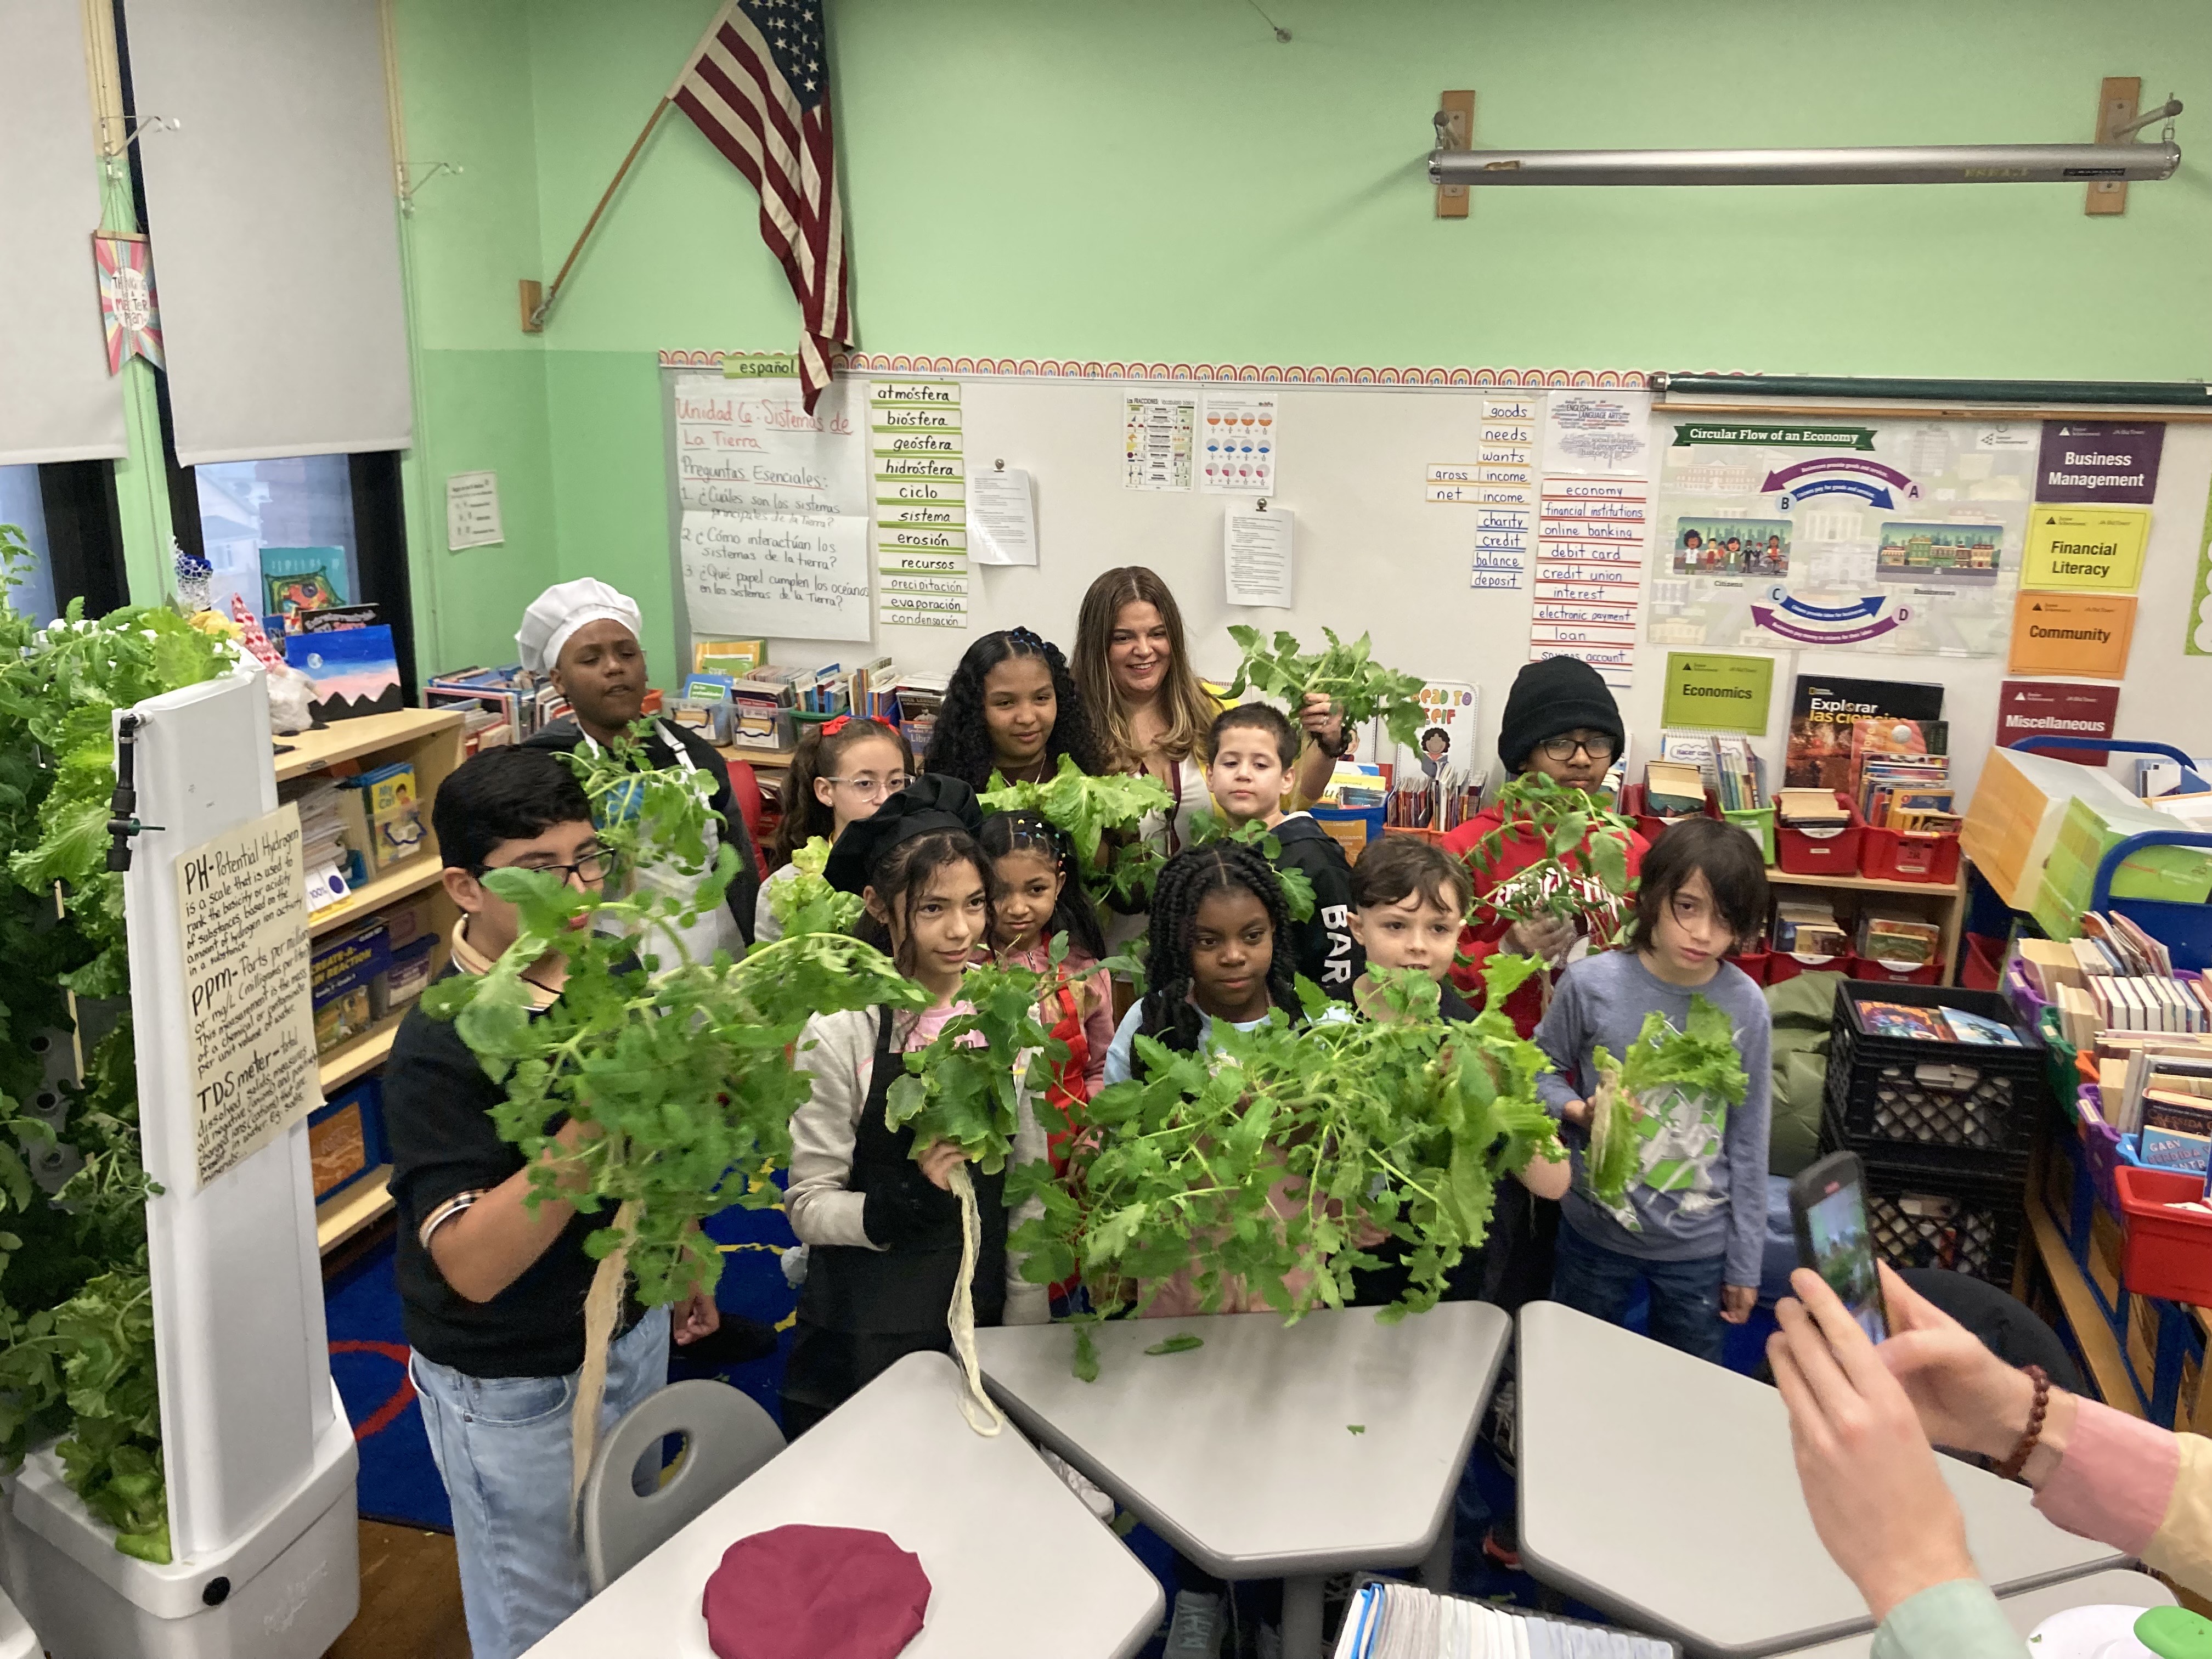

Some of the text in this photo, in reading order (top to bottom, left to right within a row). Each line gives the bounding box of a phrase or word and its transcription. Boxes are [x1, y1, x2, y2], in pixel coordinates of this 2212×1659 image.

[740, 360, 794, 377] español
[878, 385, 950, 402] atmósfera
[675, 399, 733, 421] Unidad
[761, 399, 824, 432] Sistemas
[830, 411, 853, 433] de
[888, 411, 948, 425] biósfera
[1489, 404, 1527, 417] goods
[684, 429, 762, 449] La Tierra
[1486, 427, 1527, 441] needs
[1690, 428, 1737, 439] Circular
[1739, 430, 1768, 440] Flow
[1771, 431, 1782, 440] of
[1803, 431, 1859, 444] Economy
[893, 435, 952, 452] geósfera
[1483, 448, 1525, 462] wants
[2065, 452, 2132, 466] Business
[681, 455, 828, 488] Preguntas Esenciales:
[886, 459, 954, 476] hidrósfera
[1436, 470, 1527, 482] gross income
[2049, 472, 2145, 488] Management
[900, 484, 937, 498] ciclo
[1437, 487, 1525, 503] net income
[1566, 487, 1623, 496] economy
[1908, 486, 1919, 498] A
[751, 495, 769, 505] son
[773, 493, 788, 509] los
[795, 494, 840, 514] sistemas
[1545, 501, 1643, 517] financial institutions
[1781, 497, 1790, 510] B
[771, 511, 785, 522] de
[801, 515, 834, 528] Tierra?
[898, 507, 950, 522] sistema
[1483, 511, 1523, 528] charity
[1545, 522, 1632, 539] online banking
[748, 529, 811, 550] interactúan
[818, 537, 836, 553] los
[898, 533, 949, 546] erosión
[1482, 533, 1521, 546] credit
[2051, 540, 2117, 555] Financial
[702, 545, 756, 560] sistemas
[765, 550, 777, 561] de
[785, 551, 794, 563] la
[1476, 551, 1519, 567] balance
[1551, 544, 1620, 560] debit card
[902, 559, 955, 569] recursos
[2052, 561, 2110, 578] Literacy
[1475, 571, 1517, 588] deposit
[1543, 565, 1622, 582] credit union
[736, 569, 764, 589] papel
[769, 573, 809, 591] cumplen
[815, 575, 828, 591] los
[831, 582, 869, 597] océanos
[891, 579, 962, 592] precipitación
[1554, 583, 1605, 599] interest
[700, 583, 843, 611] en los sistemas de la Tierra?
[1772, 588, 1780, 600] C
[891, 598, 961, 611] evaporación
[892, 612, 958, 627] condensación
[1539, 605, 1631, 622] electronic payment
[1899, 609, 1908, 620] D
[1555, 627, 1585, 640] loan
[2030, 625, 2111, 644] Community
[1585, 650, 1626, 662] account
[1454, 690, 1472, 706] TO
[1683, 684, 1752, 699] Economics
[1811, 697, 1878, 714] Explorar
[1809, 710, 1833, 723] las
[2006, 714, 2105, 732] Miscellaneous
[215, 839, 259, 877] Potential
[186, 856, 293, 917] is a scale that is used to
[187, 915, 206, 934] rank
[208, 907, 221, 921] the
[255, 888, 263, 898] or
[1321, 904, 1351, 983] BAR
